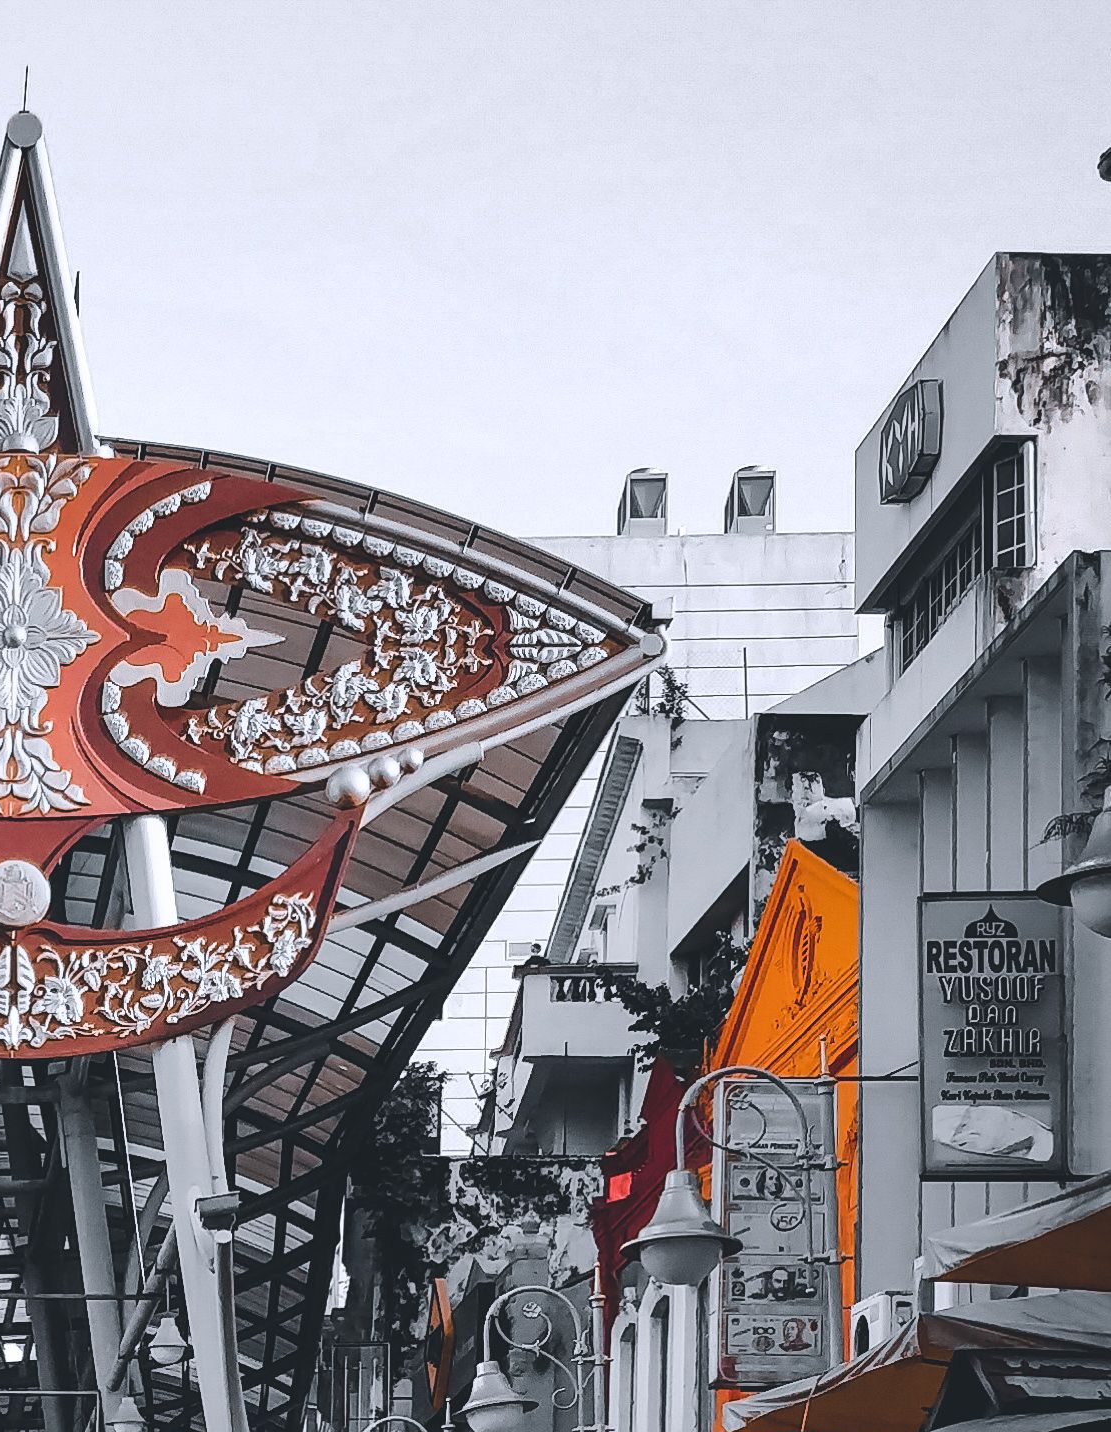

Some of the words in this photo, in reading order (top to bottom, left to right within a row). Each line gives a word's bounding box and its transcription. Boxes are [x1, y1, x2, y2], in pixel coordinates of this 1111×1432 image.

[926, 939, 1057, 974] RESTORAN
[939, 976, 1045, 1004] YUSOOF
[965, 1004, 1019, 1026] DAN
